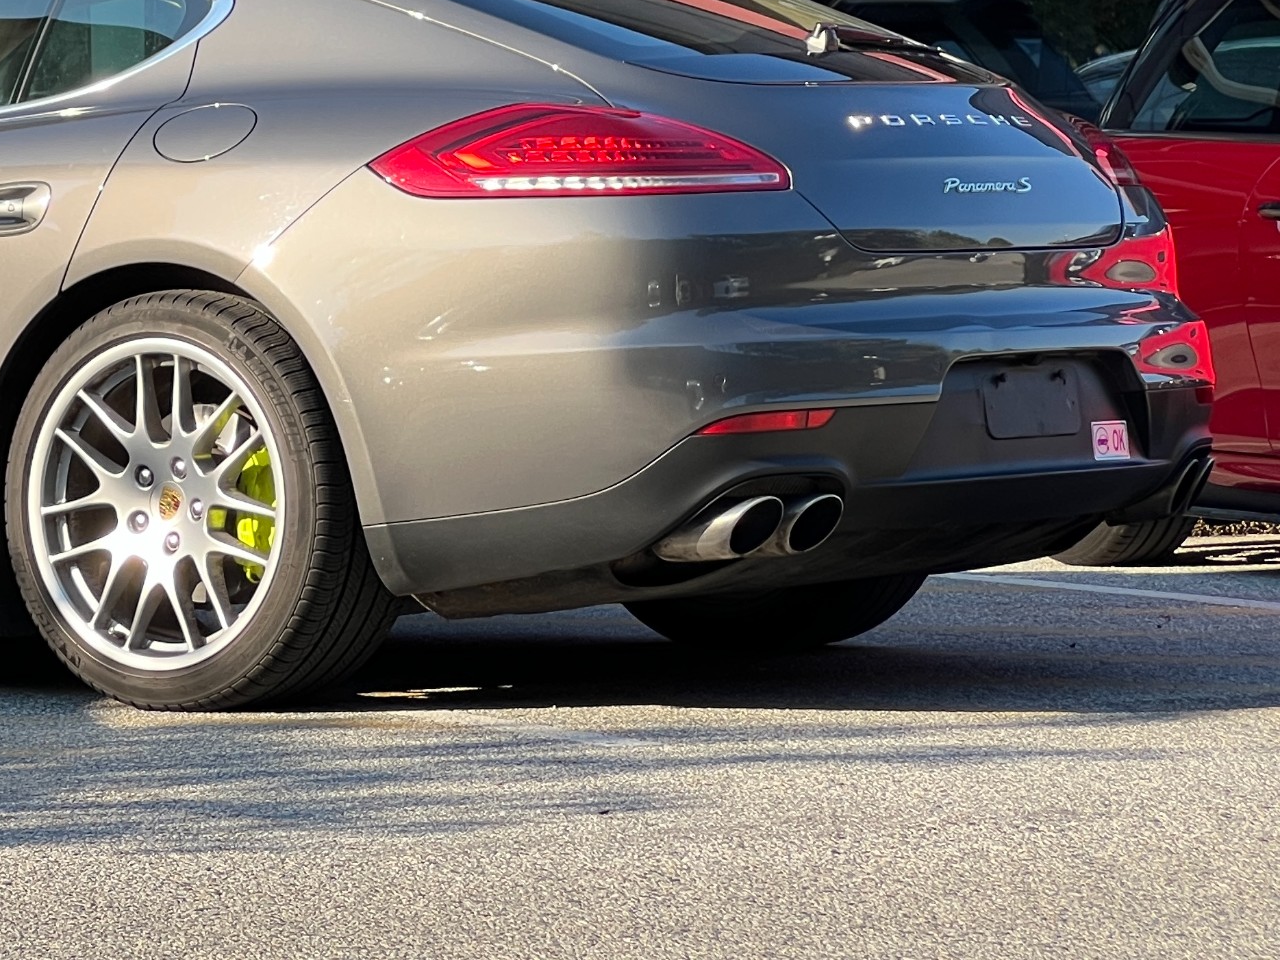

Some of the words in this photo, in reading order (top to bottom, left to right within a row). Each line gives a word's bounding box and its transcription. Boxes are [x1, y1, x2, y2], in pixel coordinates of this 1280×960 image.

[848, 113, 1033, 128] PORSCHE
[943, 177, 1015, 194] Panamera
[1112, 429, 1126, 451] OK
